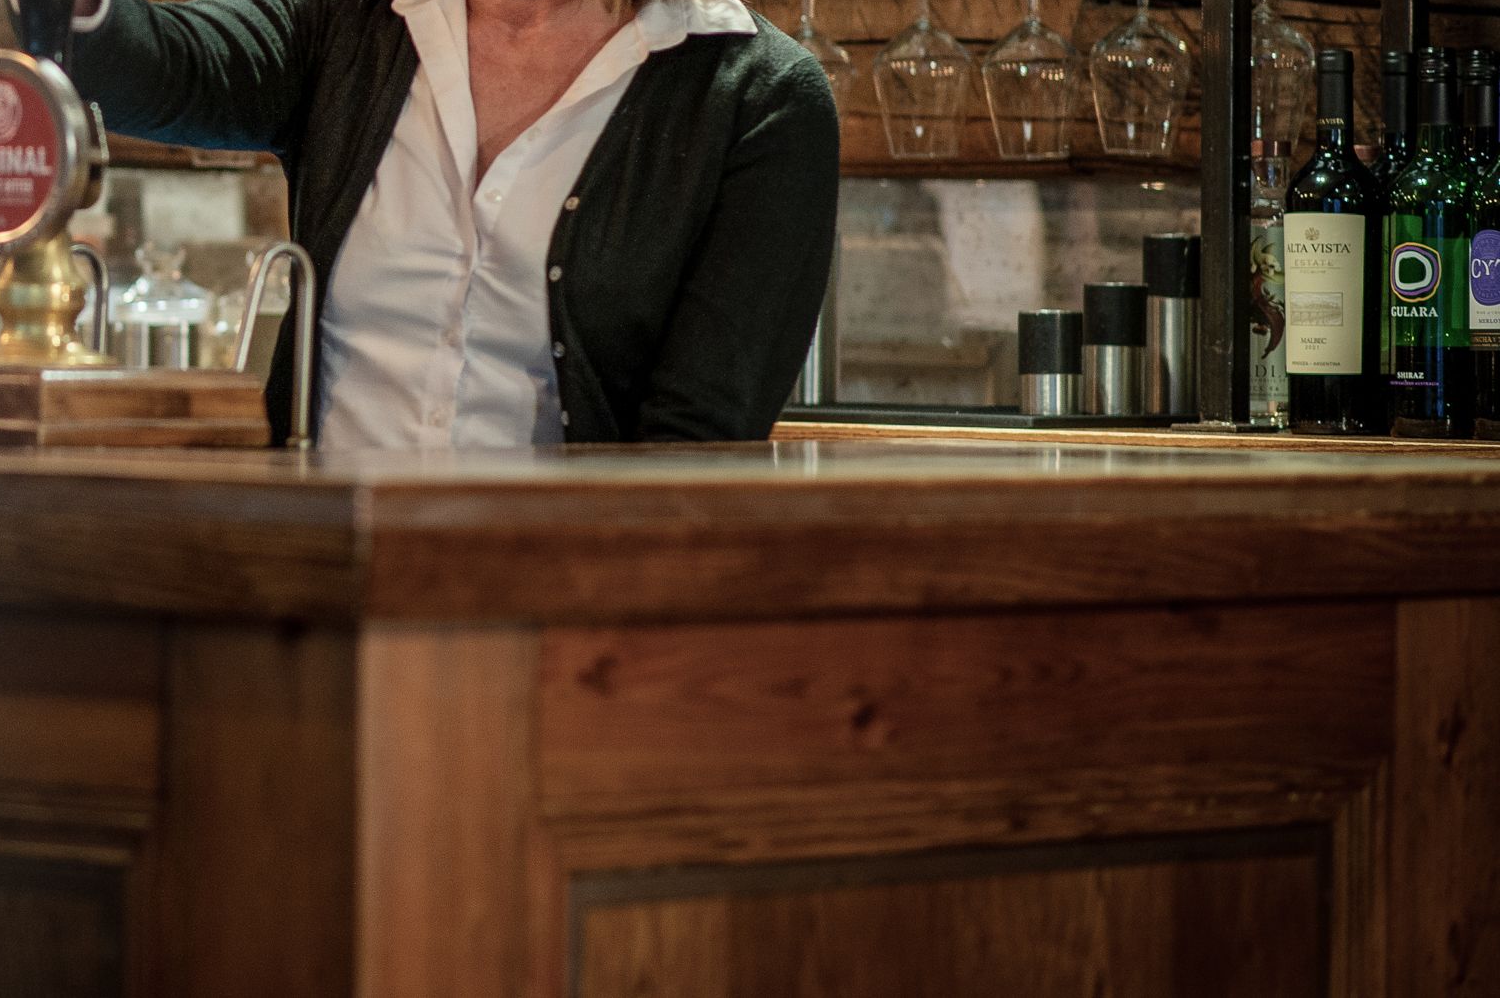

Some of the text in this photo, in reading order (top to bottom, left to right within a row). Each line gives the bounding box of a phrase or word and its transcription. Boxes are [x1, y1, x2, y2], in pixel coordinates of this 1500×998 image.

[1288, 243, 1350, 253] ALTA VISTA
[1391, 306, 1438, 317] GULARA
[1397, 371, 1424, 379] SHIRAZ
